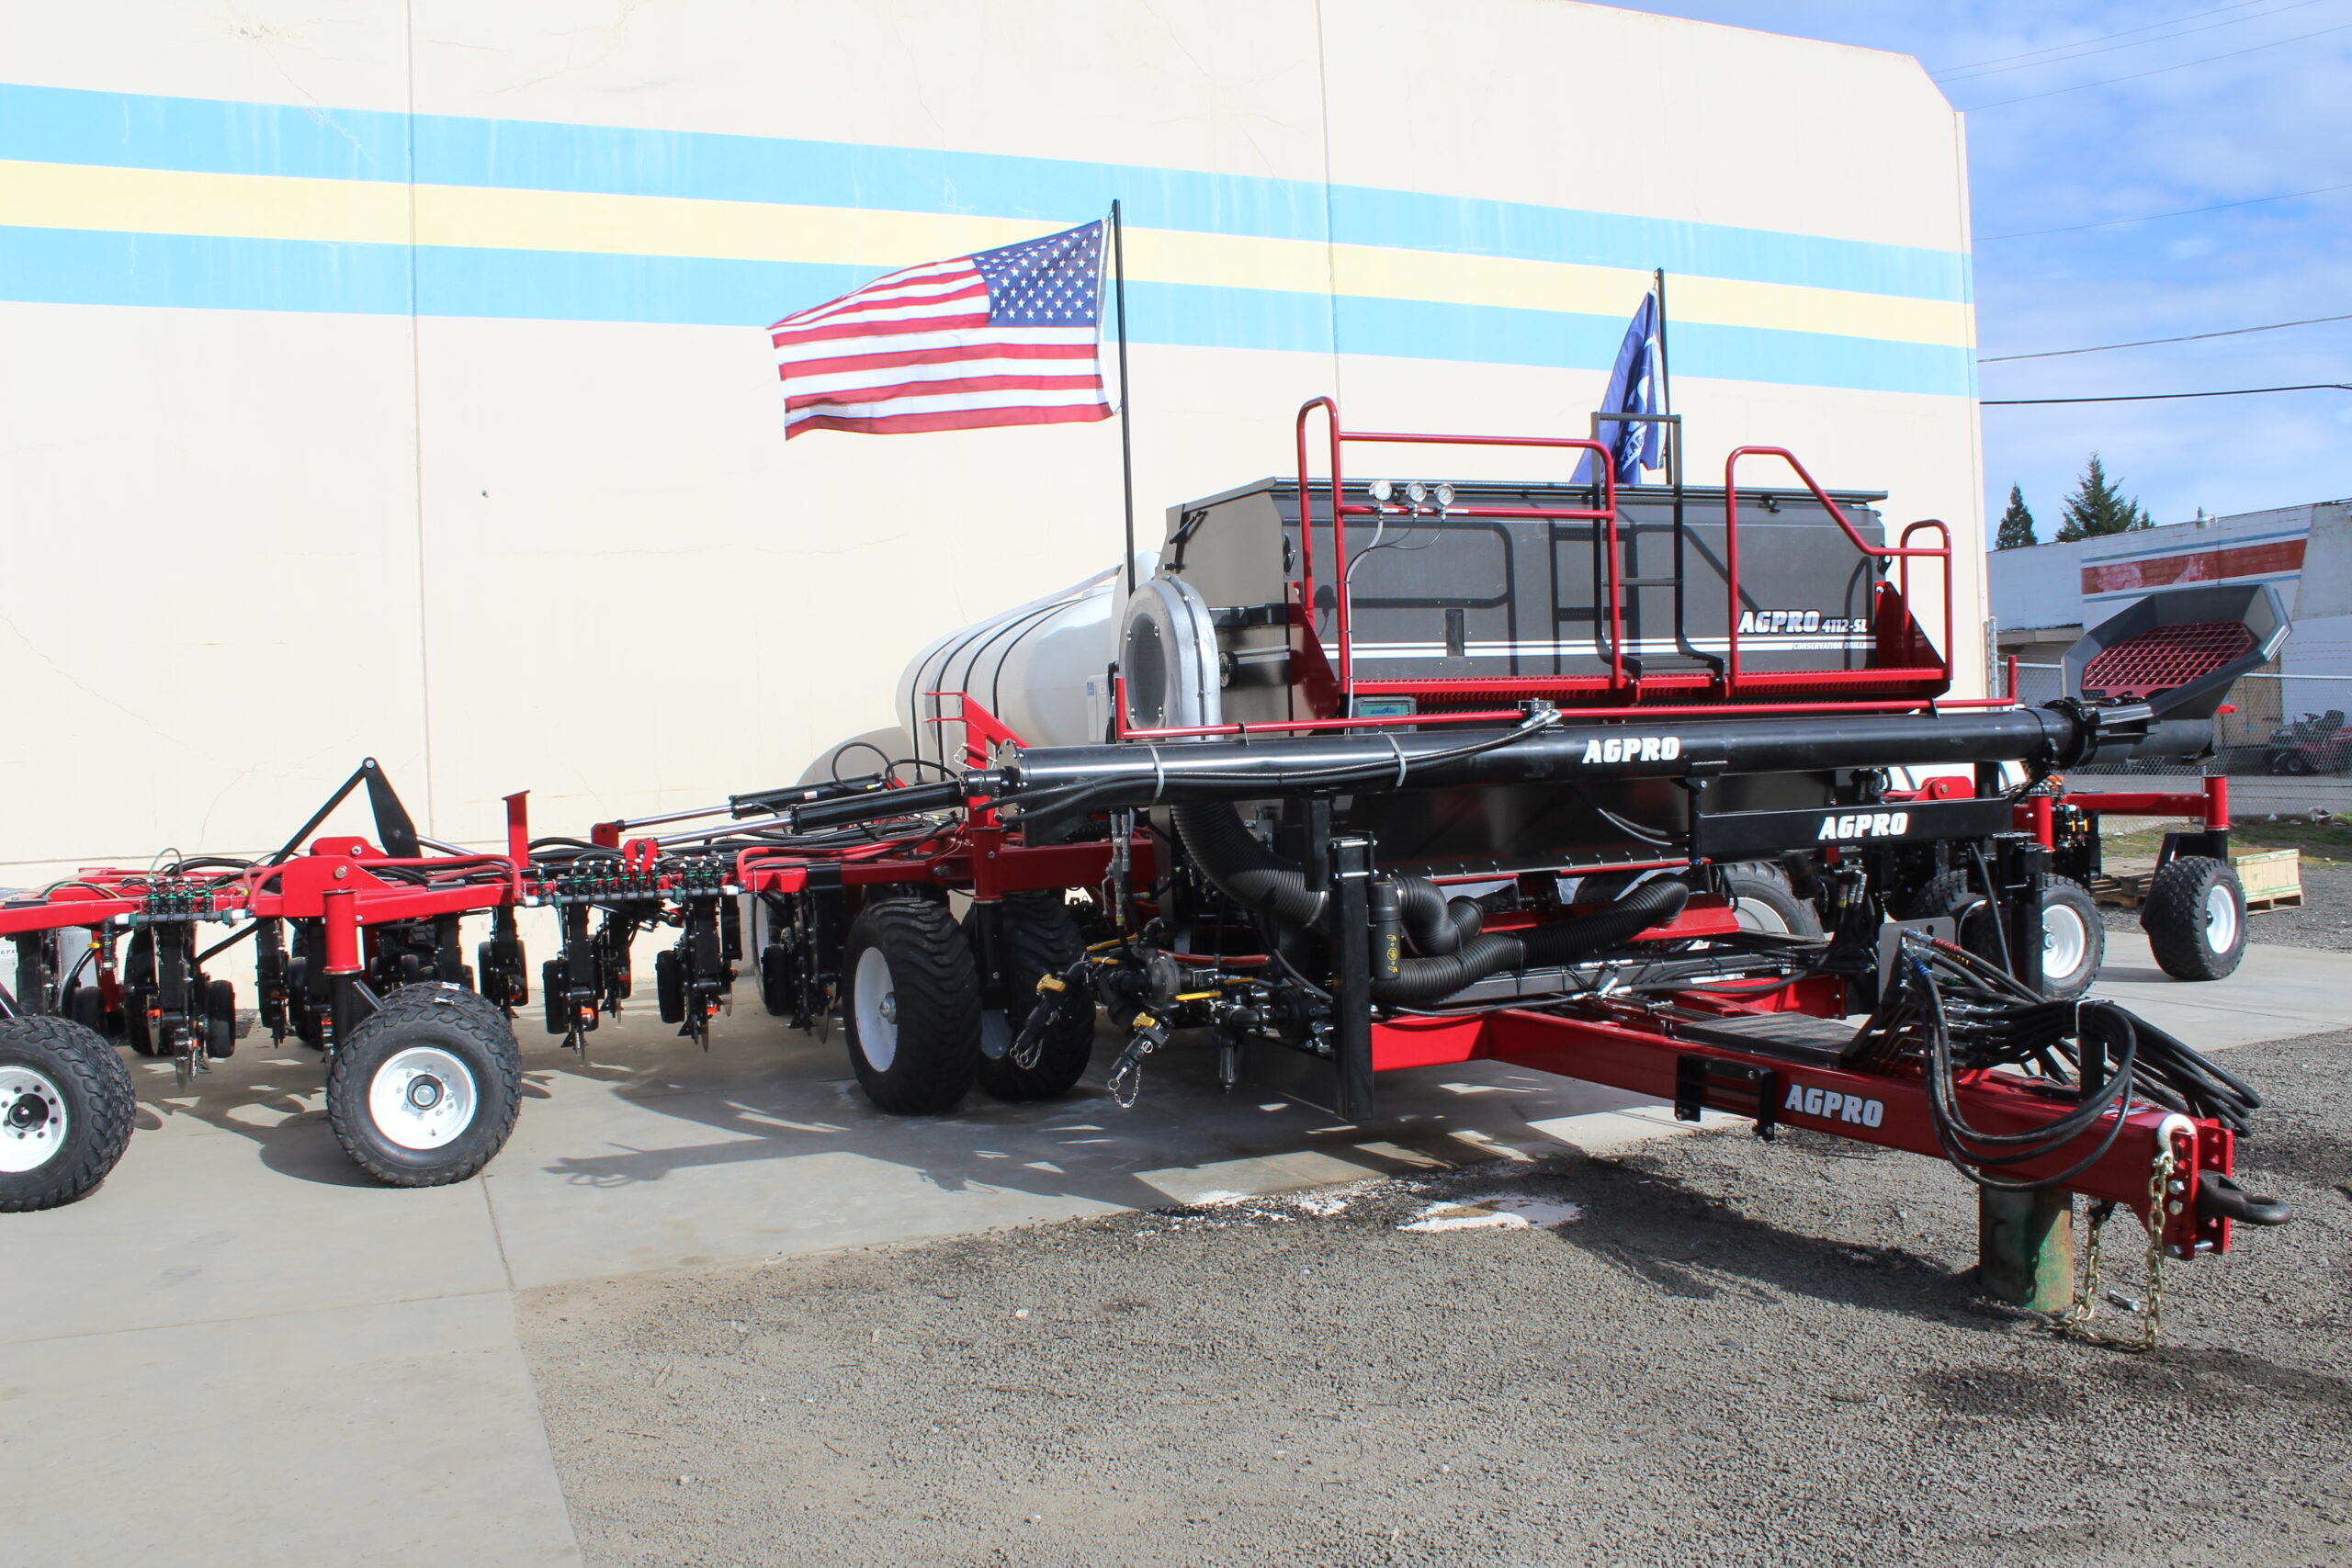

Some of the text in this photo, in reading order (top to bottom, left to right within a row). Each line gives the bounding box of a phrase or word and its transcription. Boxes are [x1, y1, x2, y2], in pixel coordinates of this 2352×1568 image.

[1737, 610, 1868, 634] AGPRO 4112-SL
[1792, 642, 1843, 650] CONSERVATION
[1581, 737, 1680, 763] AGPRO
[1817, 812, 1908, 840] AGPRO
[1784, 1084, 1883, 1128] AGPRO
